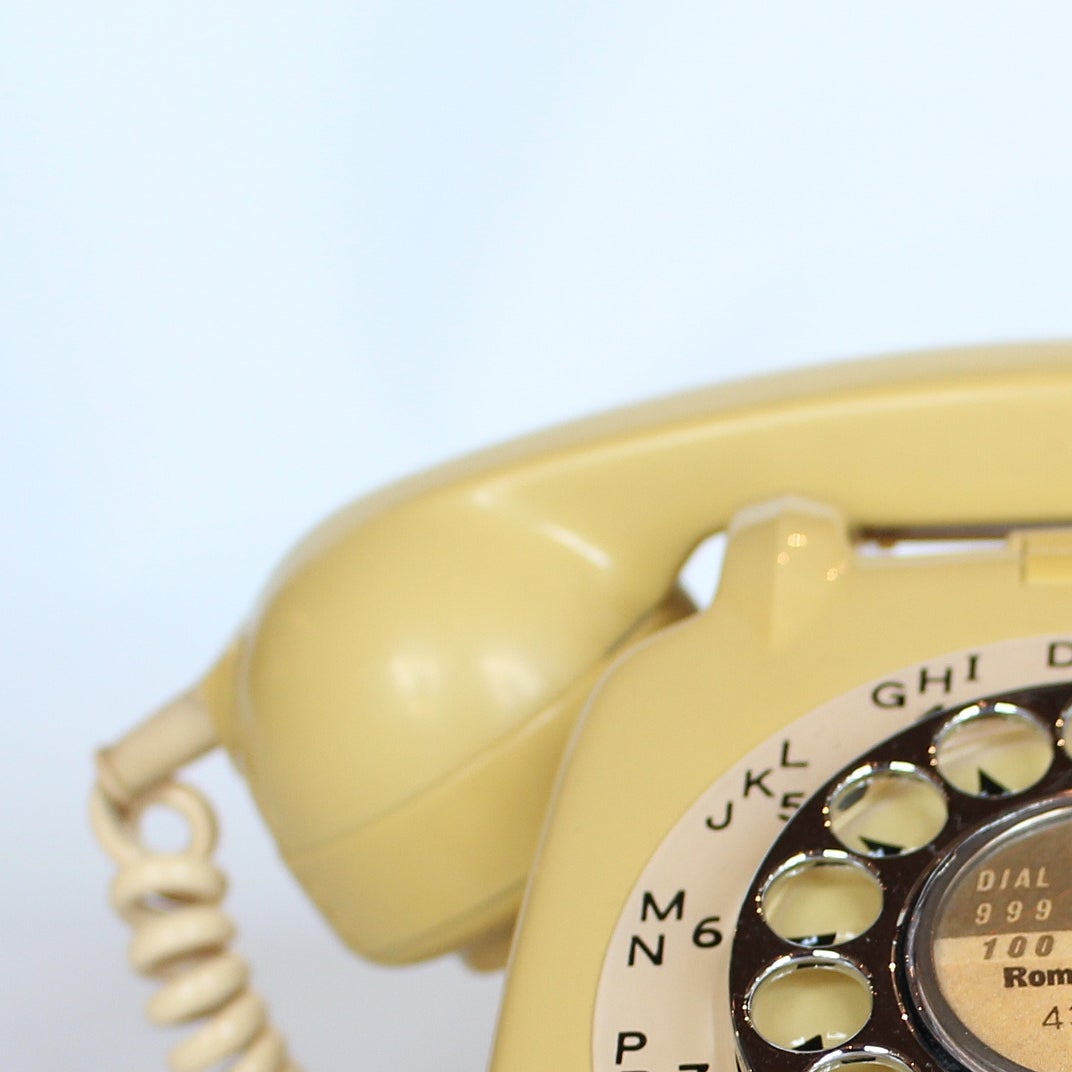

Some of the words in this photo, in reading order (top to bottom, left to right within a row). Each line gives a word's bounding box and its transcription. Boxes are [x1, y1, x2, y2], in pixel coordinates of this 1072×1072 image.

[976, 867, 1050, 892] DIAL
[692, 917, 722, 948] 6
[982, 935, 1054, 960] 100
